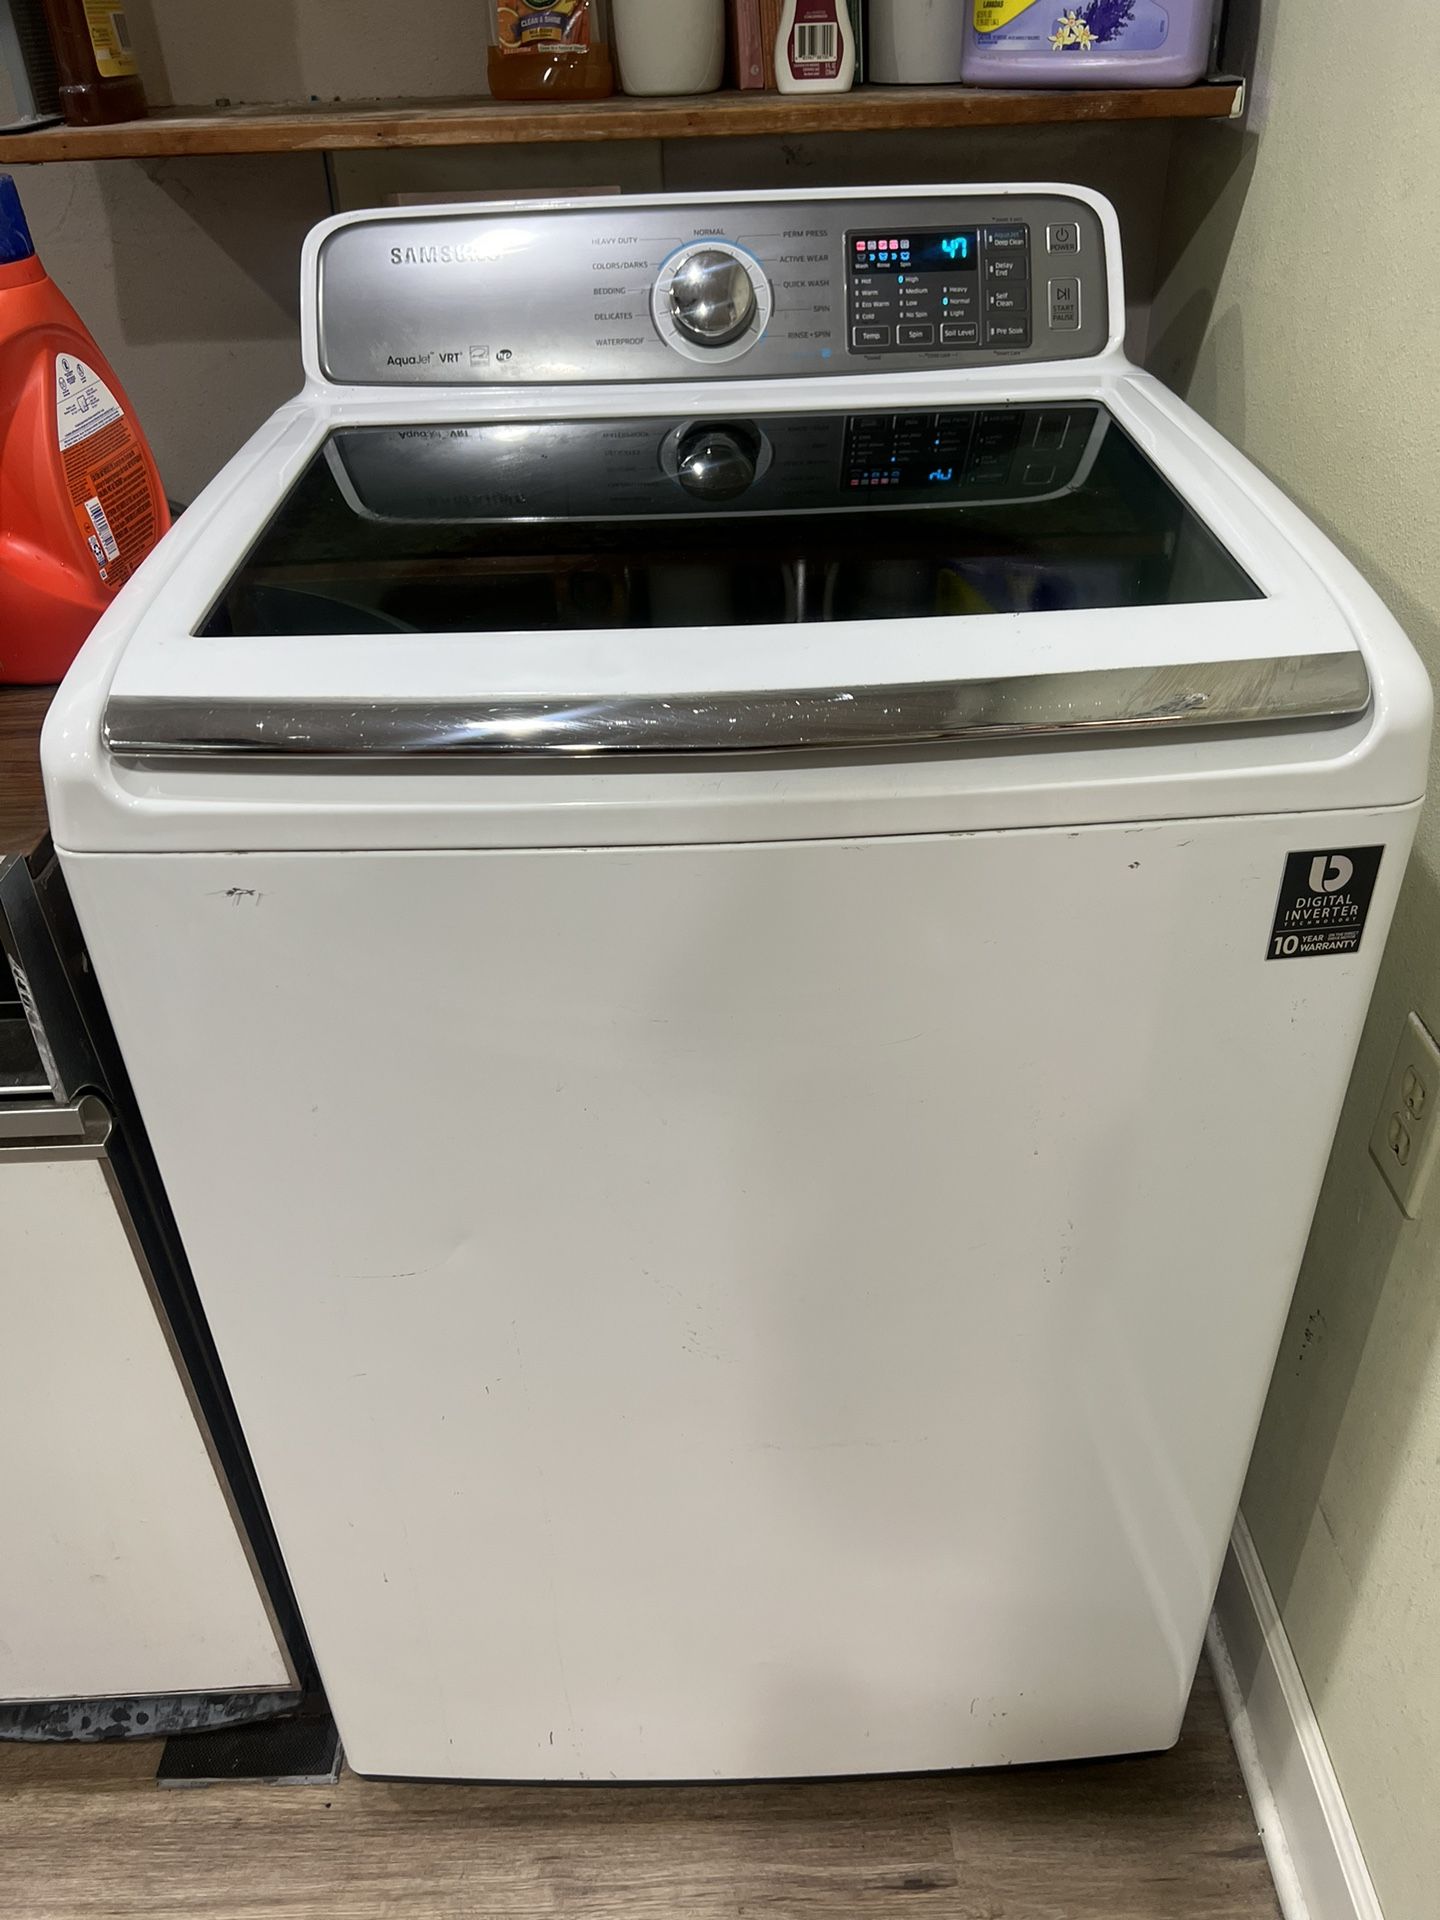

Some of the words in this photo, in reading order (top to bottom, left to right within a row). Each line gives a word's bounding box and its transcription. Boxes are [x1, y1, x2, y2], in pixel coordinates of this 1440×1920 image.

[521, 17, 539, 27] CLEAN
[693, 228, 725, 236] NORMAL
[942, 237, 967, 259] 47
[592, 262, 648, 270] COLORS/DARKS
[995, 262, 1013, 270] Delay
[905, 276, 919, 284] High
[593, 287, 626, 295] BEDDING
[1053, 304, 1074, 312] START
[594, 312, 633, 320] DELICATES
[915, 311, 928, 319] Spin
[863, 332, 881, 340] Temp
[908, 330, 923, 338] Spin
[944, 329, 956, 337] Soil
[957, 328, 975, 336] Level
[595, 337, 645, 346] WATERPROOF
[1296, 894, 1352, 908] DIGITAL
[1285, 905, 1358, 921] INVERTER
[1274, 935, 1299, 955] 10
[1302, 934, 1324, 942] YEAR
[1300, 940, 1357, 952] WARRANTY
